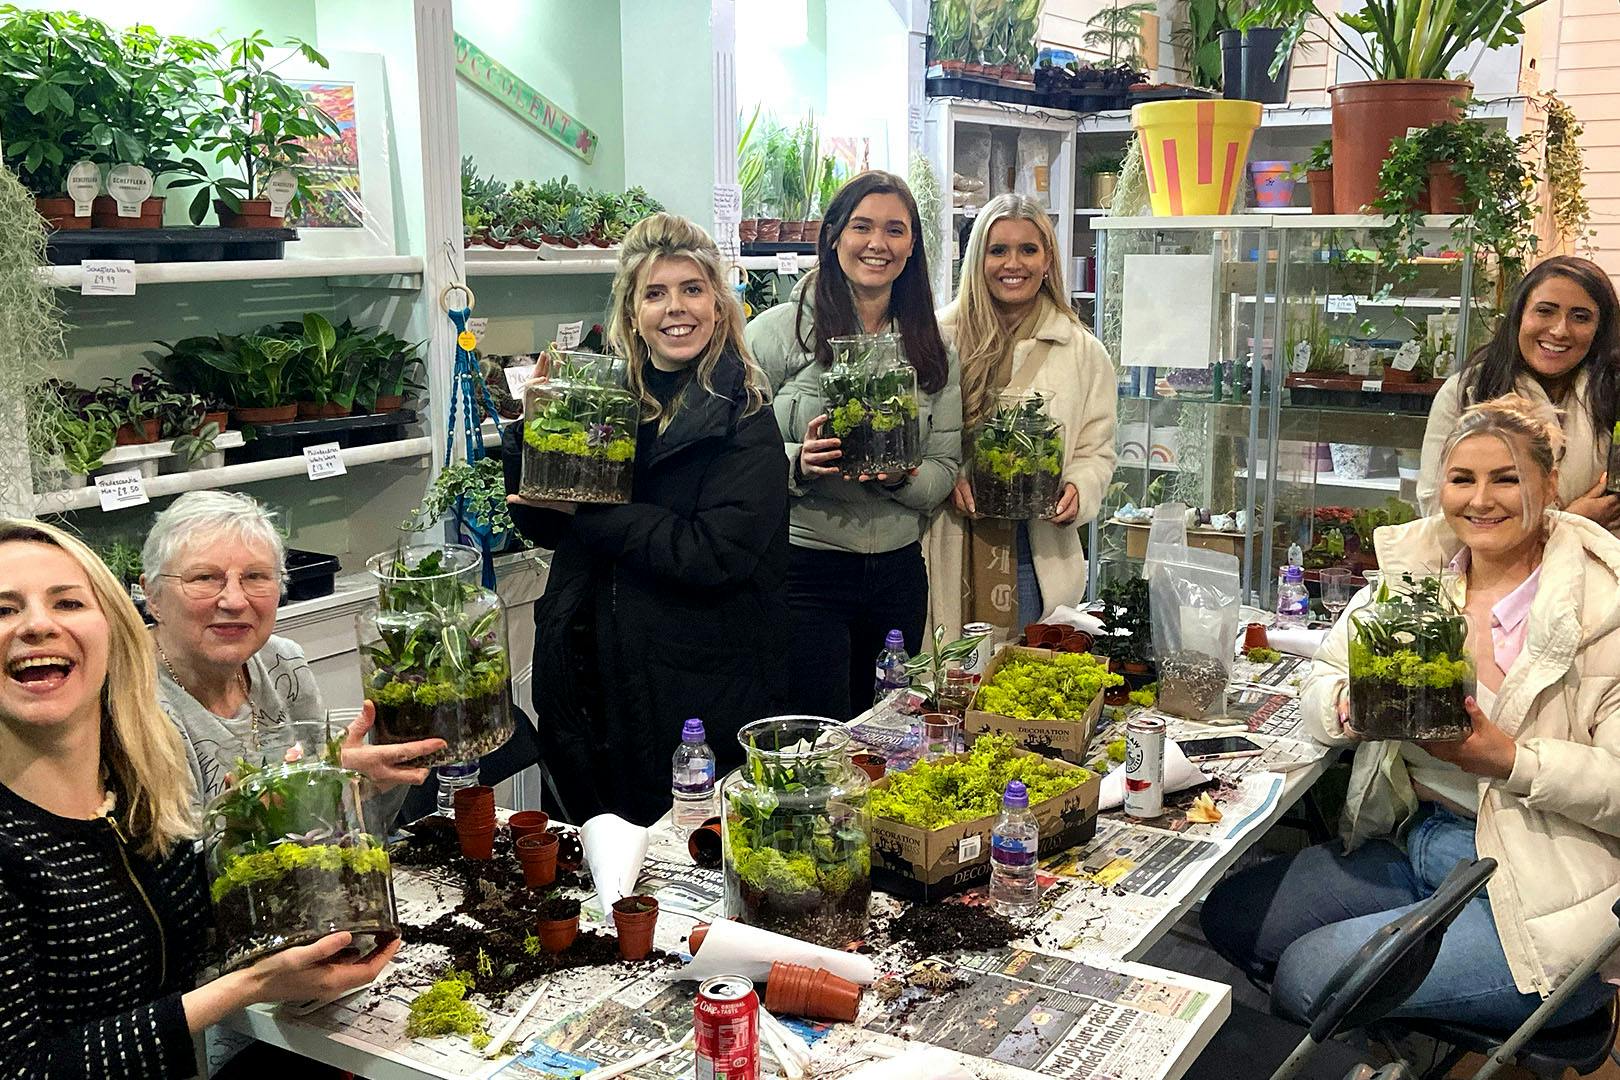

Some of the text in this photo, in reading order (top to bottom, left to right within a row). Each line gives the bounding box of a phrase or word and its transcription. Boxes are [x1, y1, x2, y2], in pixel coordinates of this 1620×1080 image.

[455, 41, 572, 138] UCCULENT
[1017, 726, 1071, 737] DECORATION
[700, 1001, 718, 1015] Coke
[1089, 1029, 1117, 1053] from
[1106, 1008, 1140, 1037] home
[1061, 1026, 1099, 1061] picture
[1088, 1002, 1118, 1029] racist
